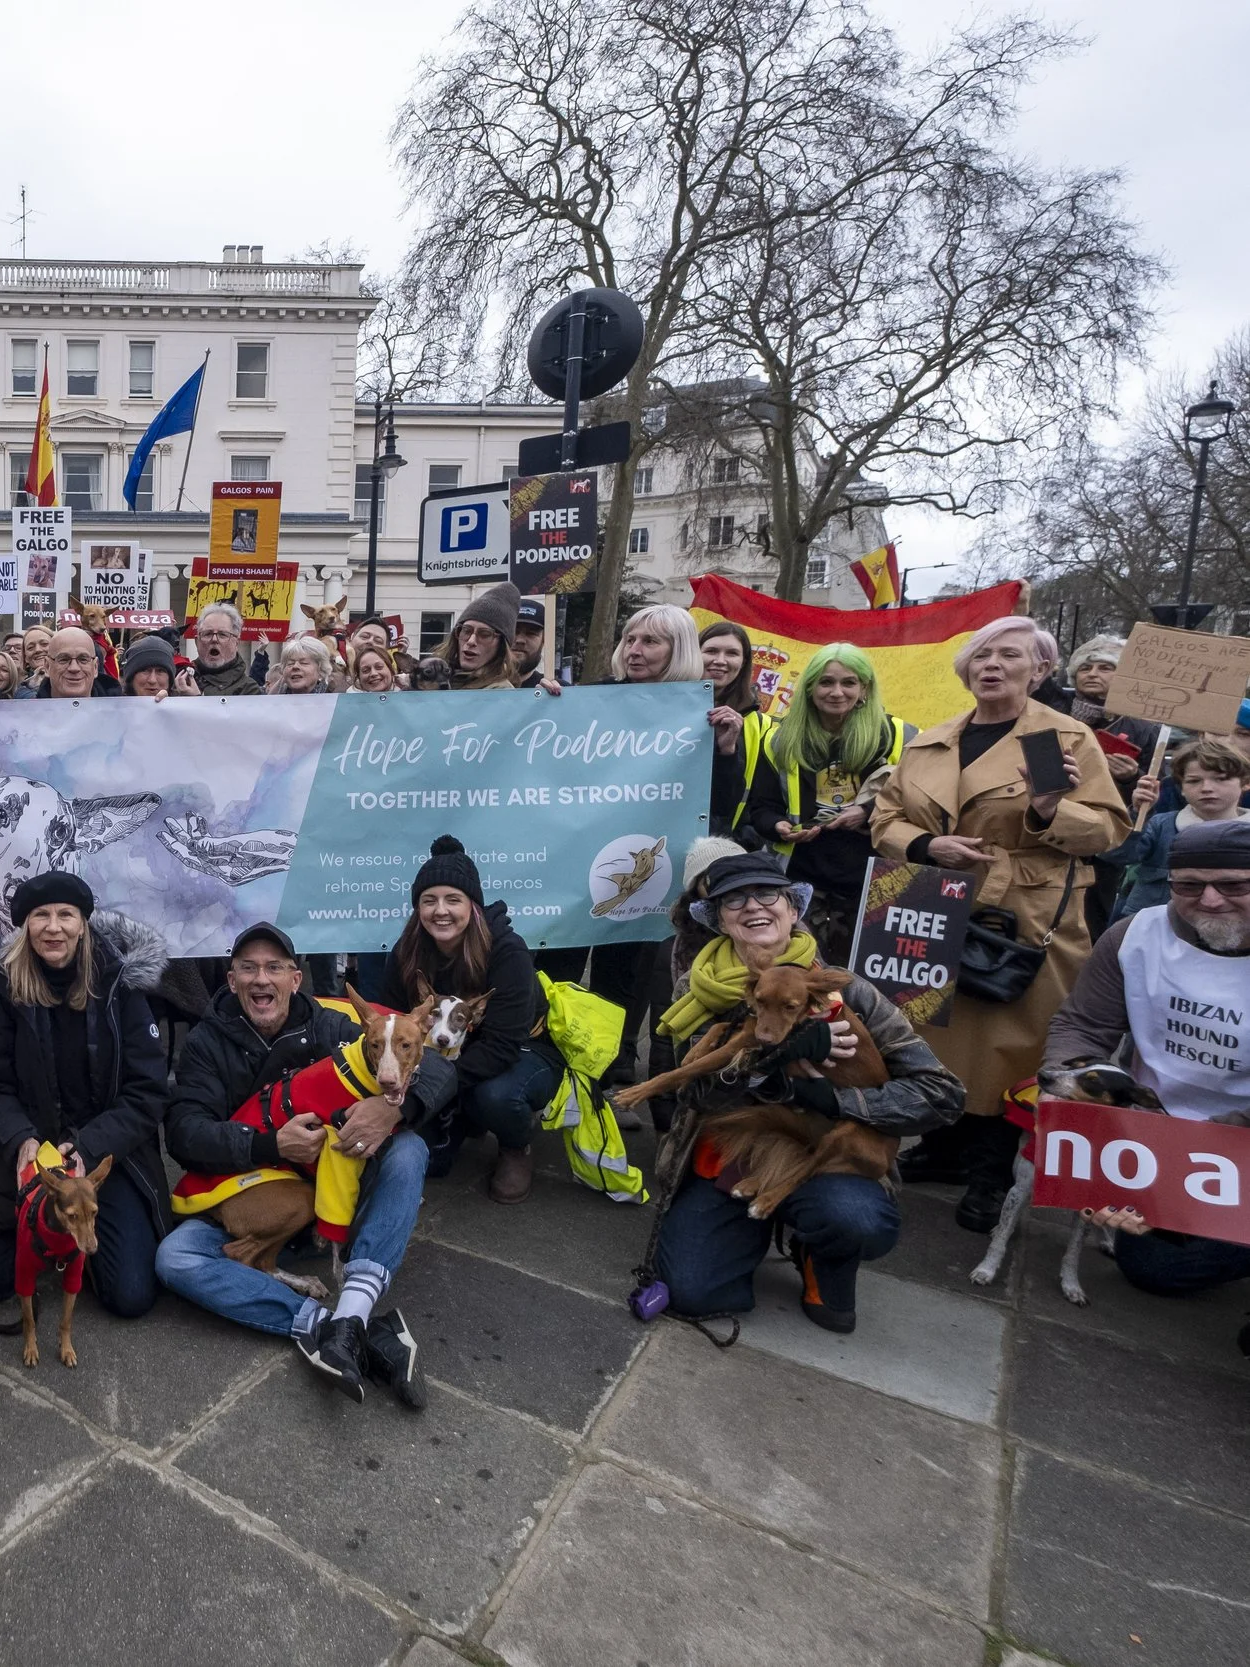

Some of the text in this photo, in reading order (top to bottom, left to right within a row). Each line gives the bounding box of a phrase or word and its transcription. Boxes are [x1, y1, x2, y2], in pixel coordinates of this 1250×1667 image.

[20, 510, 65, 524] FREE
[528, 507, 580, 531] FREE
[29, 526, 55, 536] THE
[449, 508, 478, 548] P
[540, 531, 568, 545] THE
[16, 538, 69, 551] GALGO
[515, 544, 593, 565] PODENCO
[212, 567, 273, 575] SPANISH SHAME
[425, 557, 498, 572] Knightsbridge
[96, 572, 125, 585] NO
[84, 585, 136, 595] TO HUNTING
[84, 595, 135, 605] WITH DOGS
[129, 613, 172, 624] caza
[1135, 632, 1209, 653] GALGOS
[334, 718, 702, 776] Hope For Podencos
[347, 782, 685, 811] TOGETHER WE ARE STRONGER
[319, 852, 344, 867] We
[350, 853, 407, 868] rescue,
[513, 846, 548, 864] and
[325, 878, 385, 893] rehome
[884, 906, 948, 941] FREE
[895, 937, 928, 959] THE
[864, 953, 949, 990] GALGO
[1169, 995, 1243, 1026] IBIZAN
[1166, 1018, 1239, 1050] HOUND
[1164, 1039, 1242, 1073] RESCUE
[1044, 1130, 1240, 1206] no a
